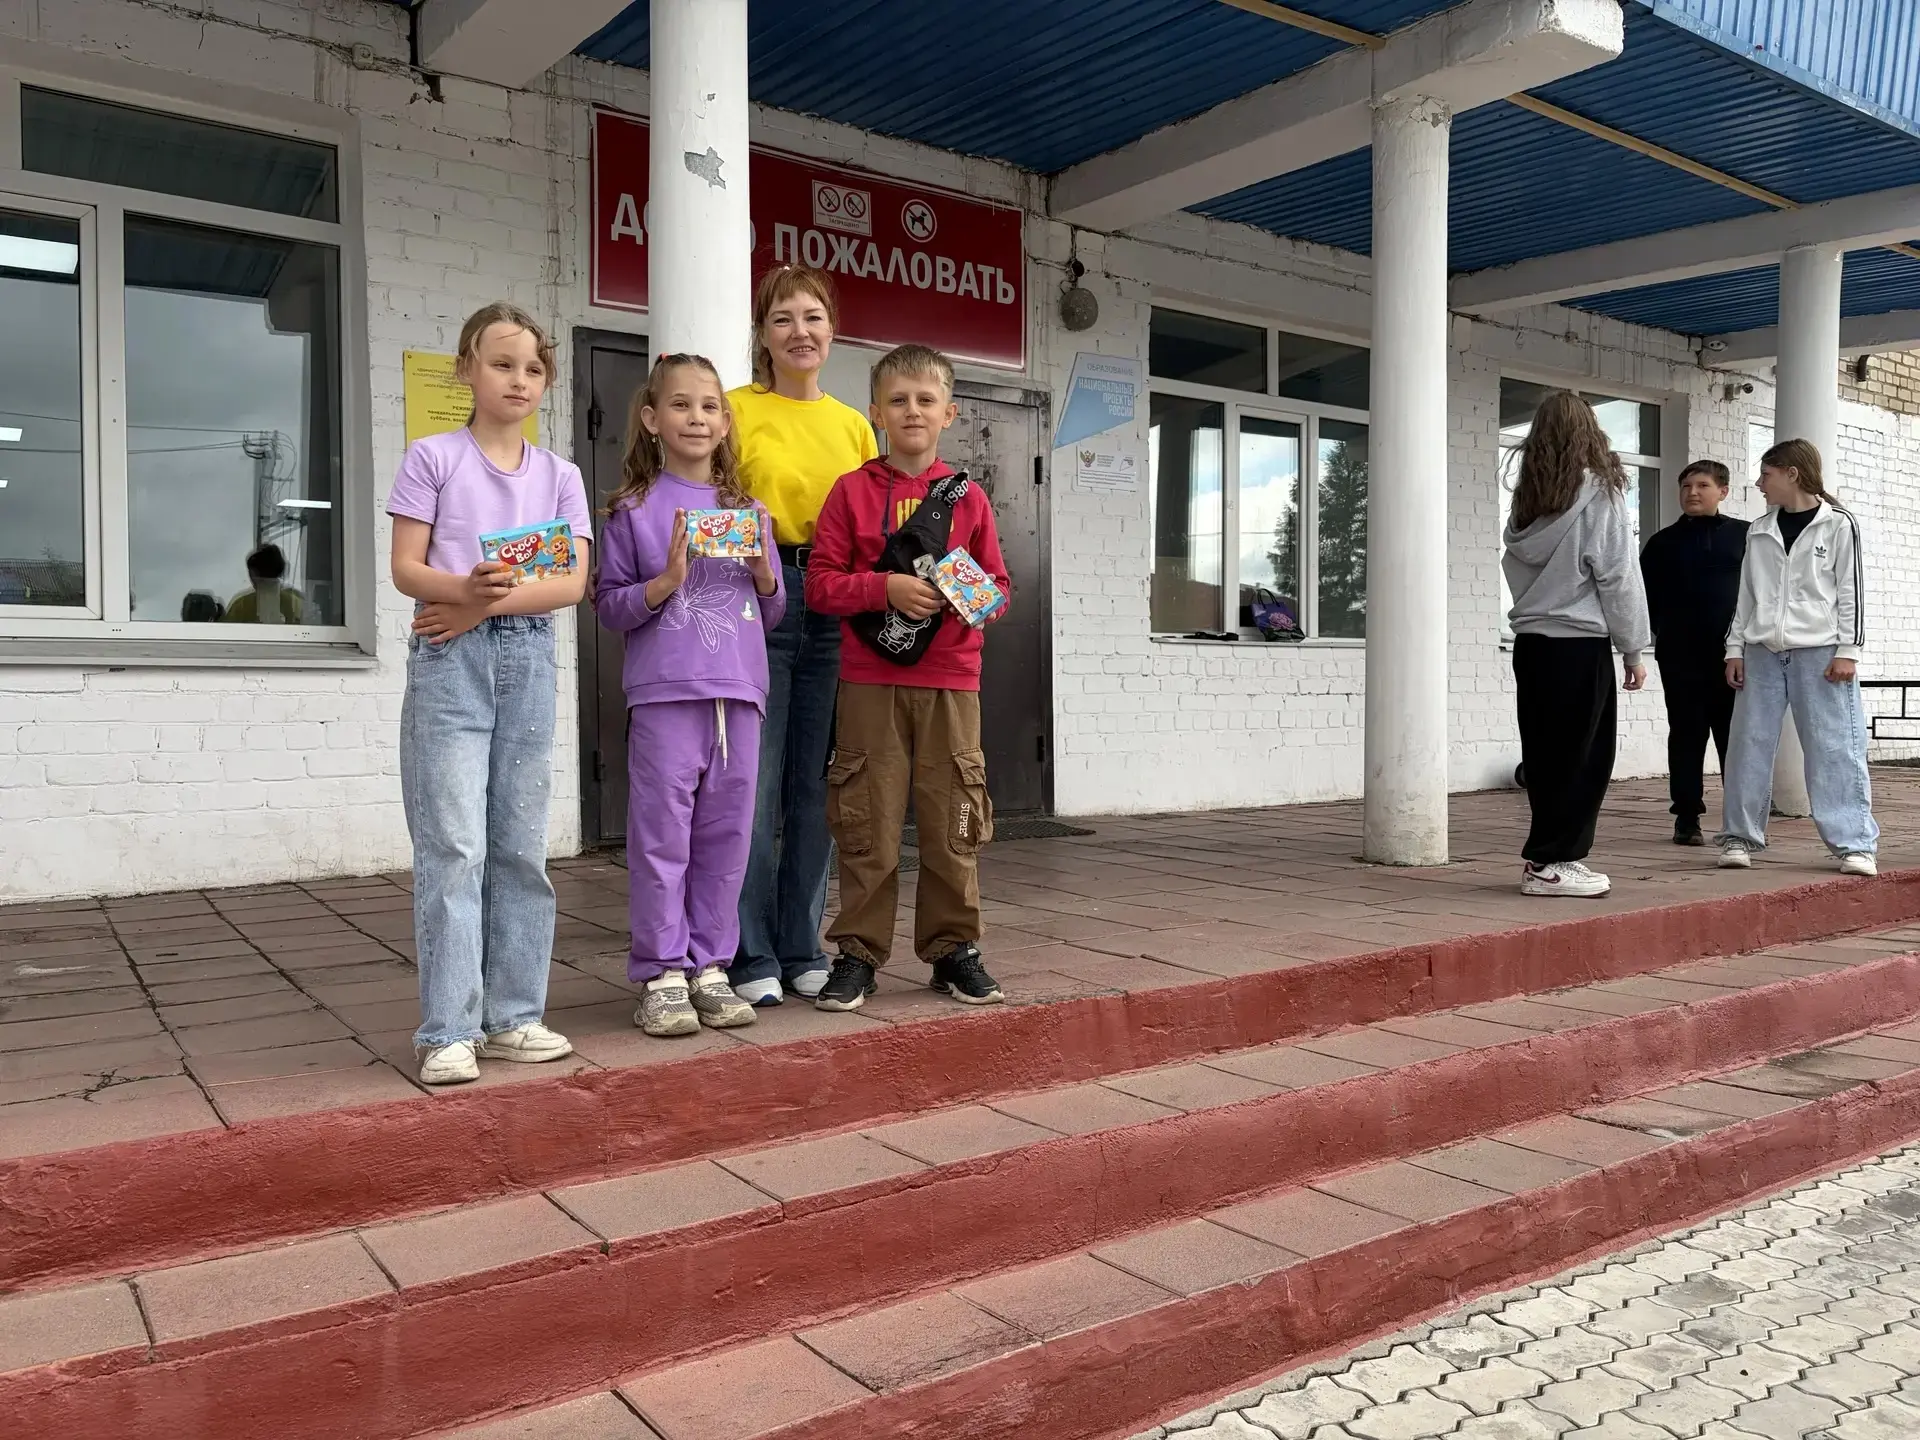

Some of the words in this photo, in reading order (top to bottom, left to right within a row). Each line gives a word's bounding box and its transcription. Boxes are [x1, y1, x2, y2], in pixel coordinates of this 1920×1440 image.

[774, 222, 1016, 305] ПОЖАЛОВАТЬ
[1086, 362, 1134, 376] ОБРАЗОВАНИЕ
[1078, 377, 1134, 393] НАЦИОНАЛЬНЫЕ
[1102, 392, 1134, 407] ПРОЕКТЫ
[1108, 405, 1134, 417] РОССИИ
[701, 514, 731, 529] Choco
[501, 535, 538, 558] Choco
[956, 560, 983, 580] Choco
